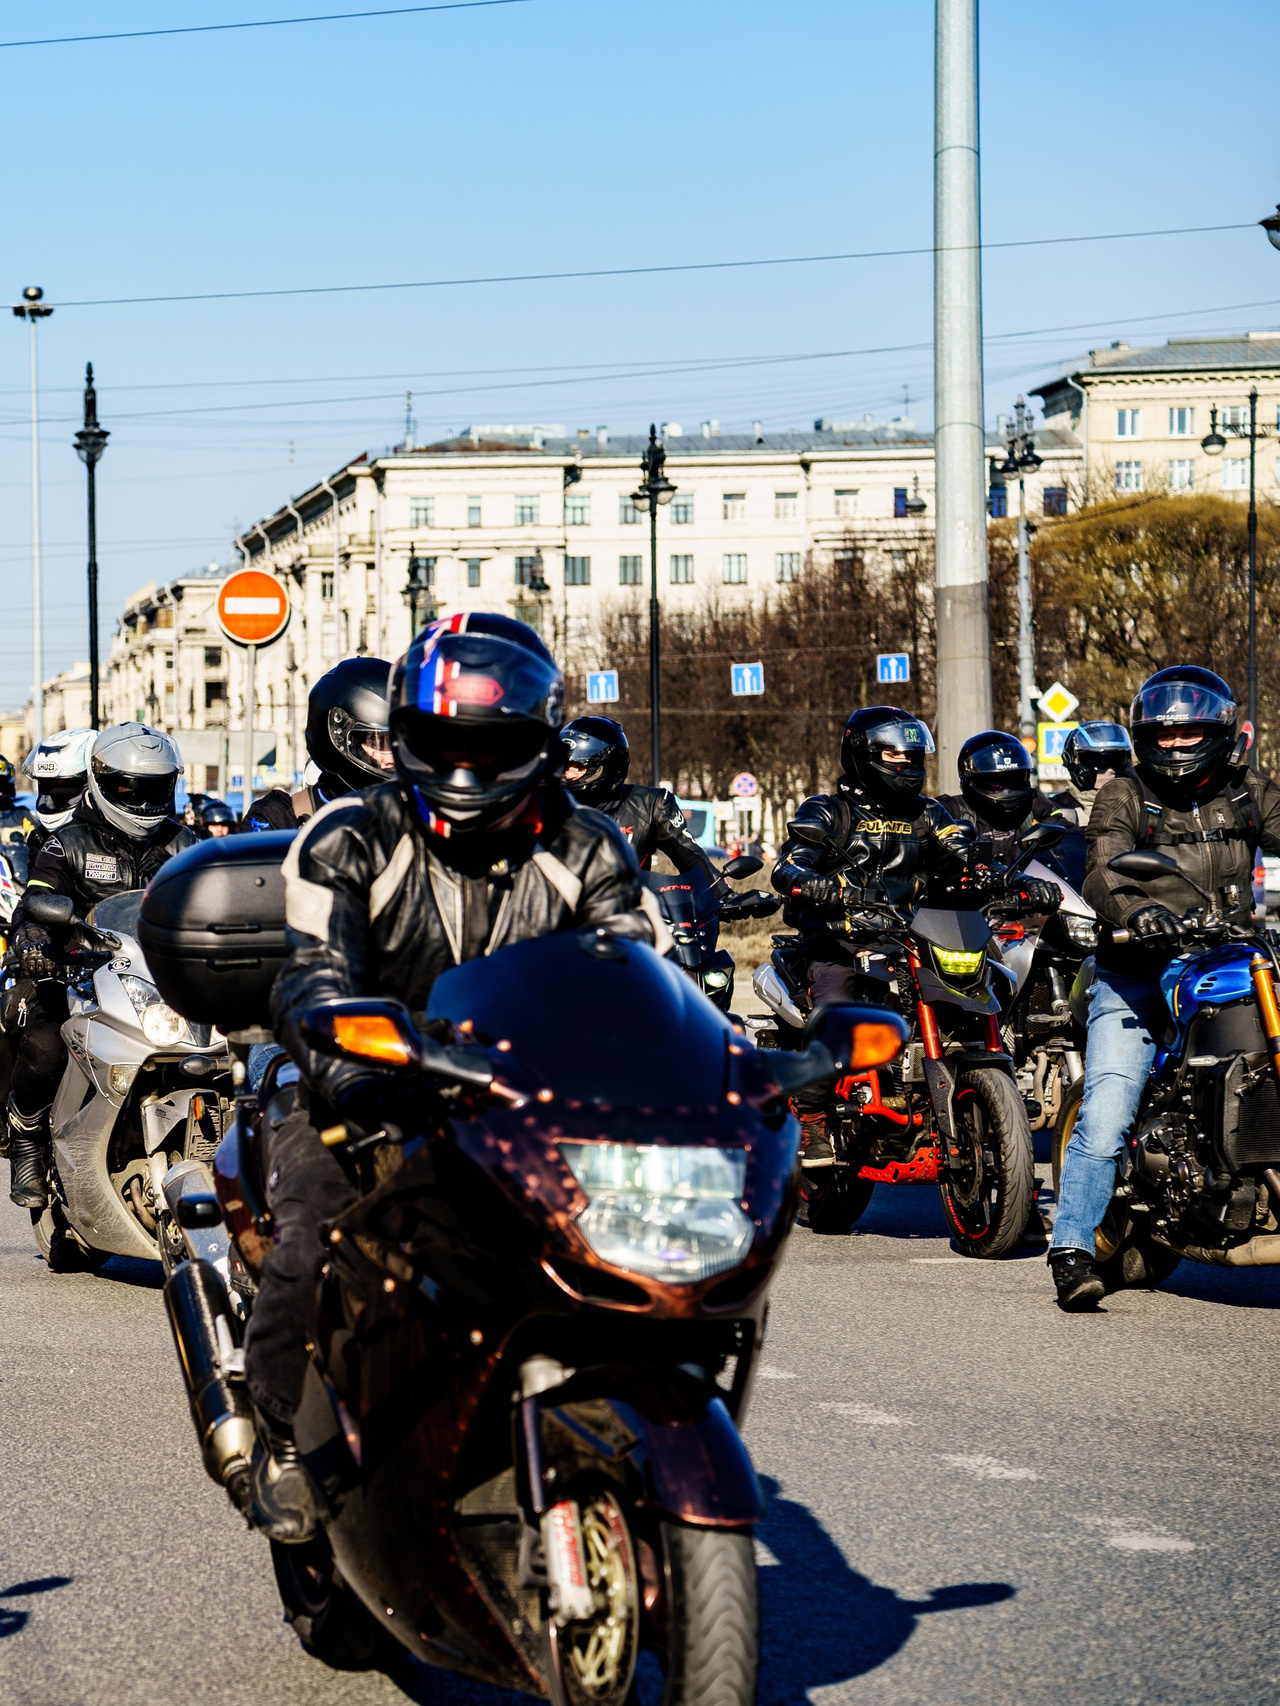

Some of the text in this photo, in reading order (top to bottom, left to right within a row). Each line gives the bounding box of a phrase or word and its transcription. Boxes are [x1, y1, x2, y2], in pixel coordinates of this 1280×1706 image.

[37, 763, 55, 771] SHOEI
[1044, 766, 1068, 777] СТО
[659, 884, 692, 893] MT-10
